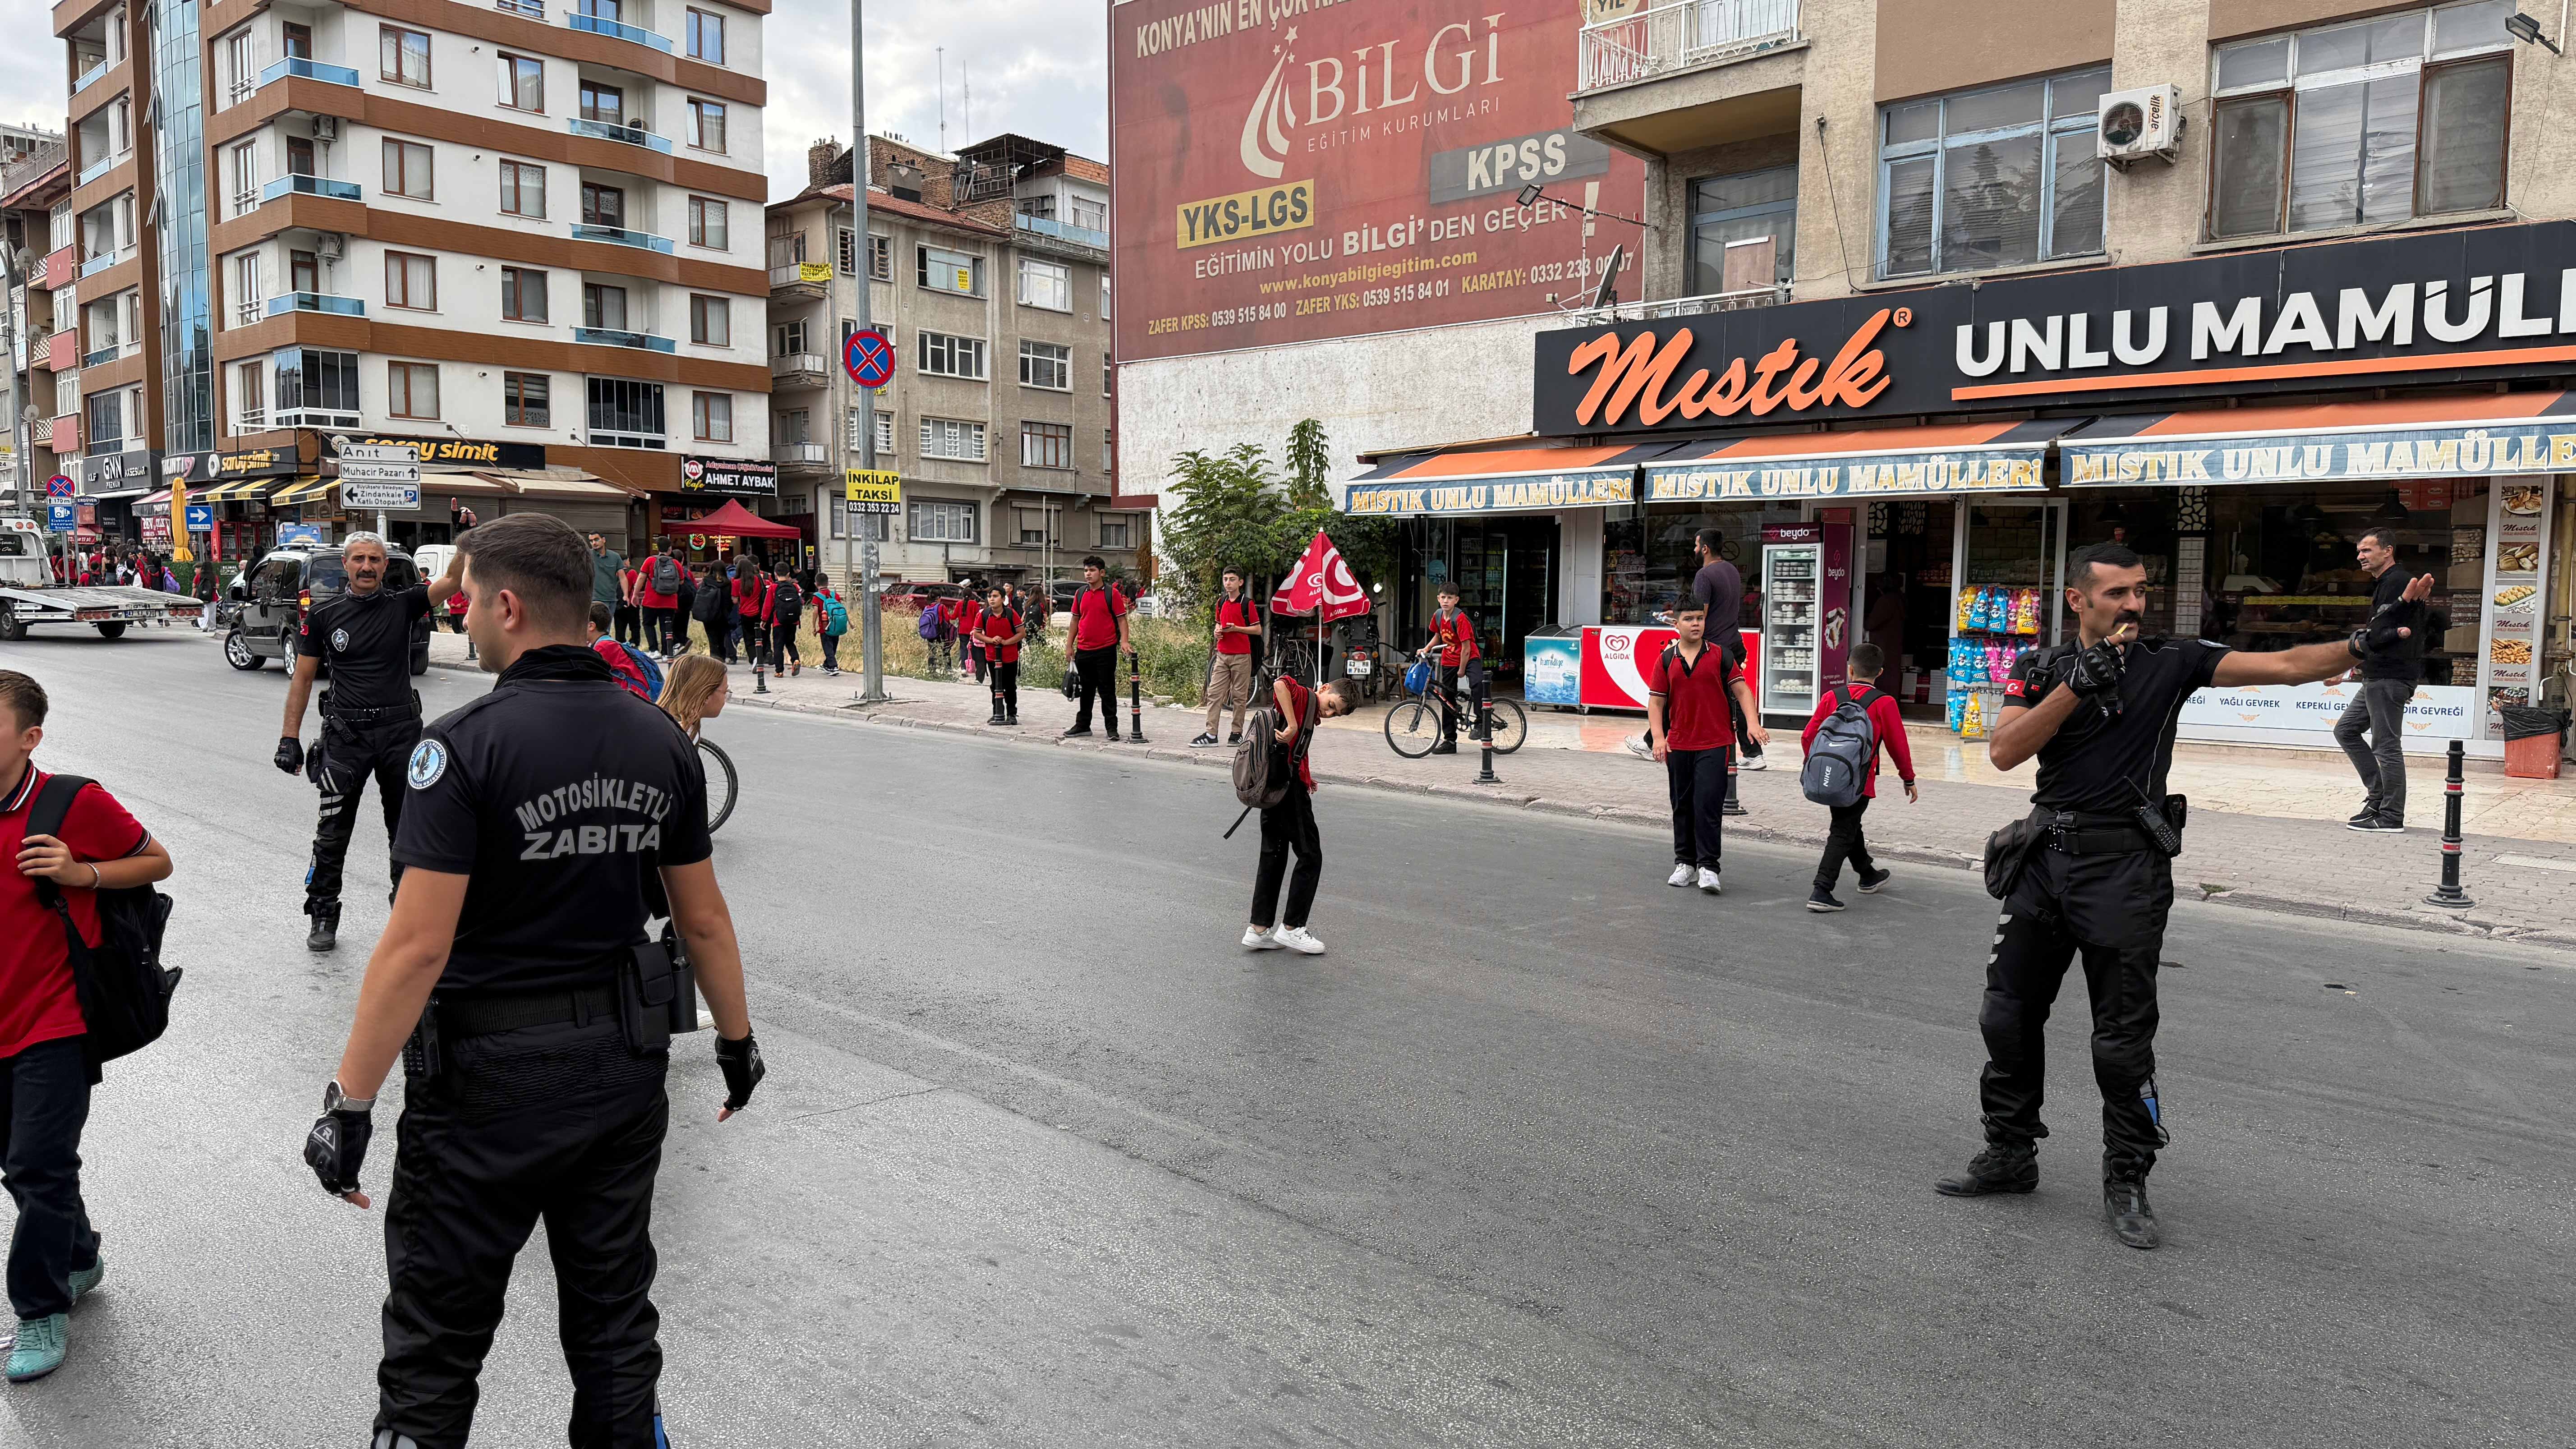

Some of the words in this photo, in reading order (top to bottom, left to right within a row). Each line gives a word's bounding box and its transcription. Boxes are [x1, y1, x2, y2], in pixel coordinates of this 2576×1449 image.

[1137, 1, 1231, 58] KONYA'NIN
[1238, 0, 1261, 31] EN
[1305, 12, 1505, 125] BİLGİ
[2150, 94, 2162, 129] arçelik
[1308, 126, 1370, 152] EĞİTİM
[1383, 97, 1500, 135] KURUMLARI
[1468, 134, 1566, 191] KPSS
[1183, 186, 1308, 241] YKS-LGS
[1196, 245, 1274, 279] EĞİTİMİN
[1281, 238, 1333, 266] YOLU
[1484, 198, 1568, 233] GEÇER
[1260, 251, 1477, 294] www.konyabilgiegitim.com
[1149, 317, 1178, 335] ZAFER
[1181, 313, 1209, 331] KPSS:
[1212, 308, 1235, 327] 0539
[1238, 306, 1256, 323] 515
[1259, 304, 1272, 321] 84
[1274, 302, 1286, 319] 00
[1296, 296, 1330, 316] ZAFER
[1334, 292, 1359, 311] YKS:
[1363, 287, 1390, 308] 0539
[1394, 283, 1414, 303] 515
[1418, 281, 1432, 299] 84
[1435, 278, 1449, 297] 01
[1462, 267, 1526, 294] KARATAY:
[1531, 262, 1562, 284] 0332
[1956, 306, 2167, 377] UNLU
[1568, 308, 1891, 426] Mıstık
[343, 446, 380, 458] Anıt
[440, 441, 499, 461] simit
[2070, 449, 2214, 484] MISTIK
[2221, 444, 2334, 480] UNLU
[2346, 429, 2576, 474] MAMÜLLE
[103, 455, 122, 480] GNN
[221, 455, 247, 474] saray
[343, 466, 377, 476] Muhacir
[379, 468, 405, 477] Pazarı
[685, 478, 705, 491] Cafe
[705, 473, 740, 486] AHMET
[742, 475, 775, 488] AYBAK
[848, 471, 899, 485] İNKİLAP
[1651, 470, 1756, 499] MISTIK
[1761, 466, 1840, 497] UNLU
[855, 488, 892, 500] TAKSİ
[1351, 489, 1426, 513] MISTIK
[1430, 485, 1487, 511] UNLU
[849, 502, 865, 512] 0332
[867, 502, 879, 512] 353
[881, 503, 889, 513] 22
[891, 504, 899, 513] 24
[1780, 529, 1809, 540] beydo
[1617, 565, 1646, 573] BEBETO
[1828, 567, 1845, 581] beydo
[2219, 696, 2243, 706] YAĞLI
[2245, 699, 2280, 708] GEVREK
[2296, 700, 2331, 710] KEPEKLİ
[2420, 706, 2463, 716] GEVREĞİ
[1823, 765, 1832, 787] NIKE
[515, 772, 674, 832] MOTOSİKLETLİ
[520, 824, 660, 860] ZABITA
